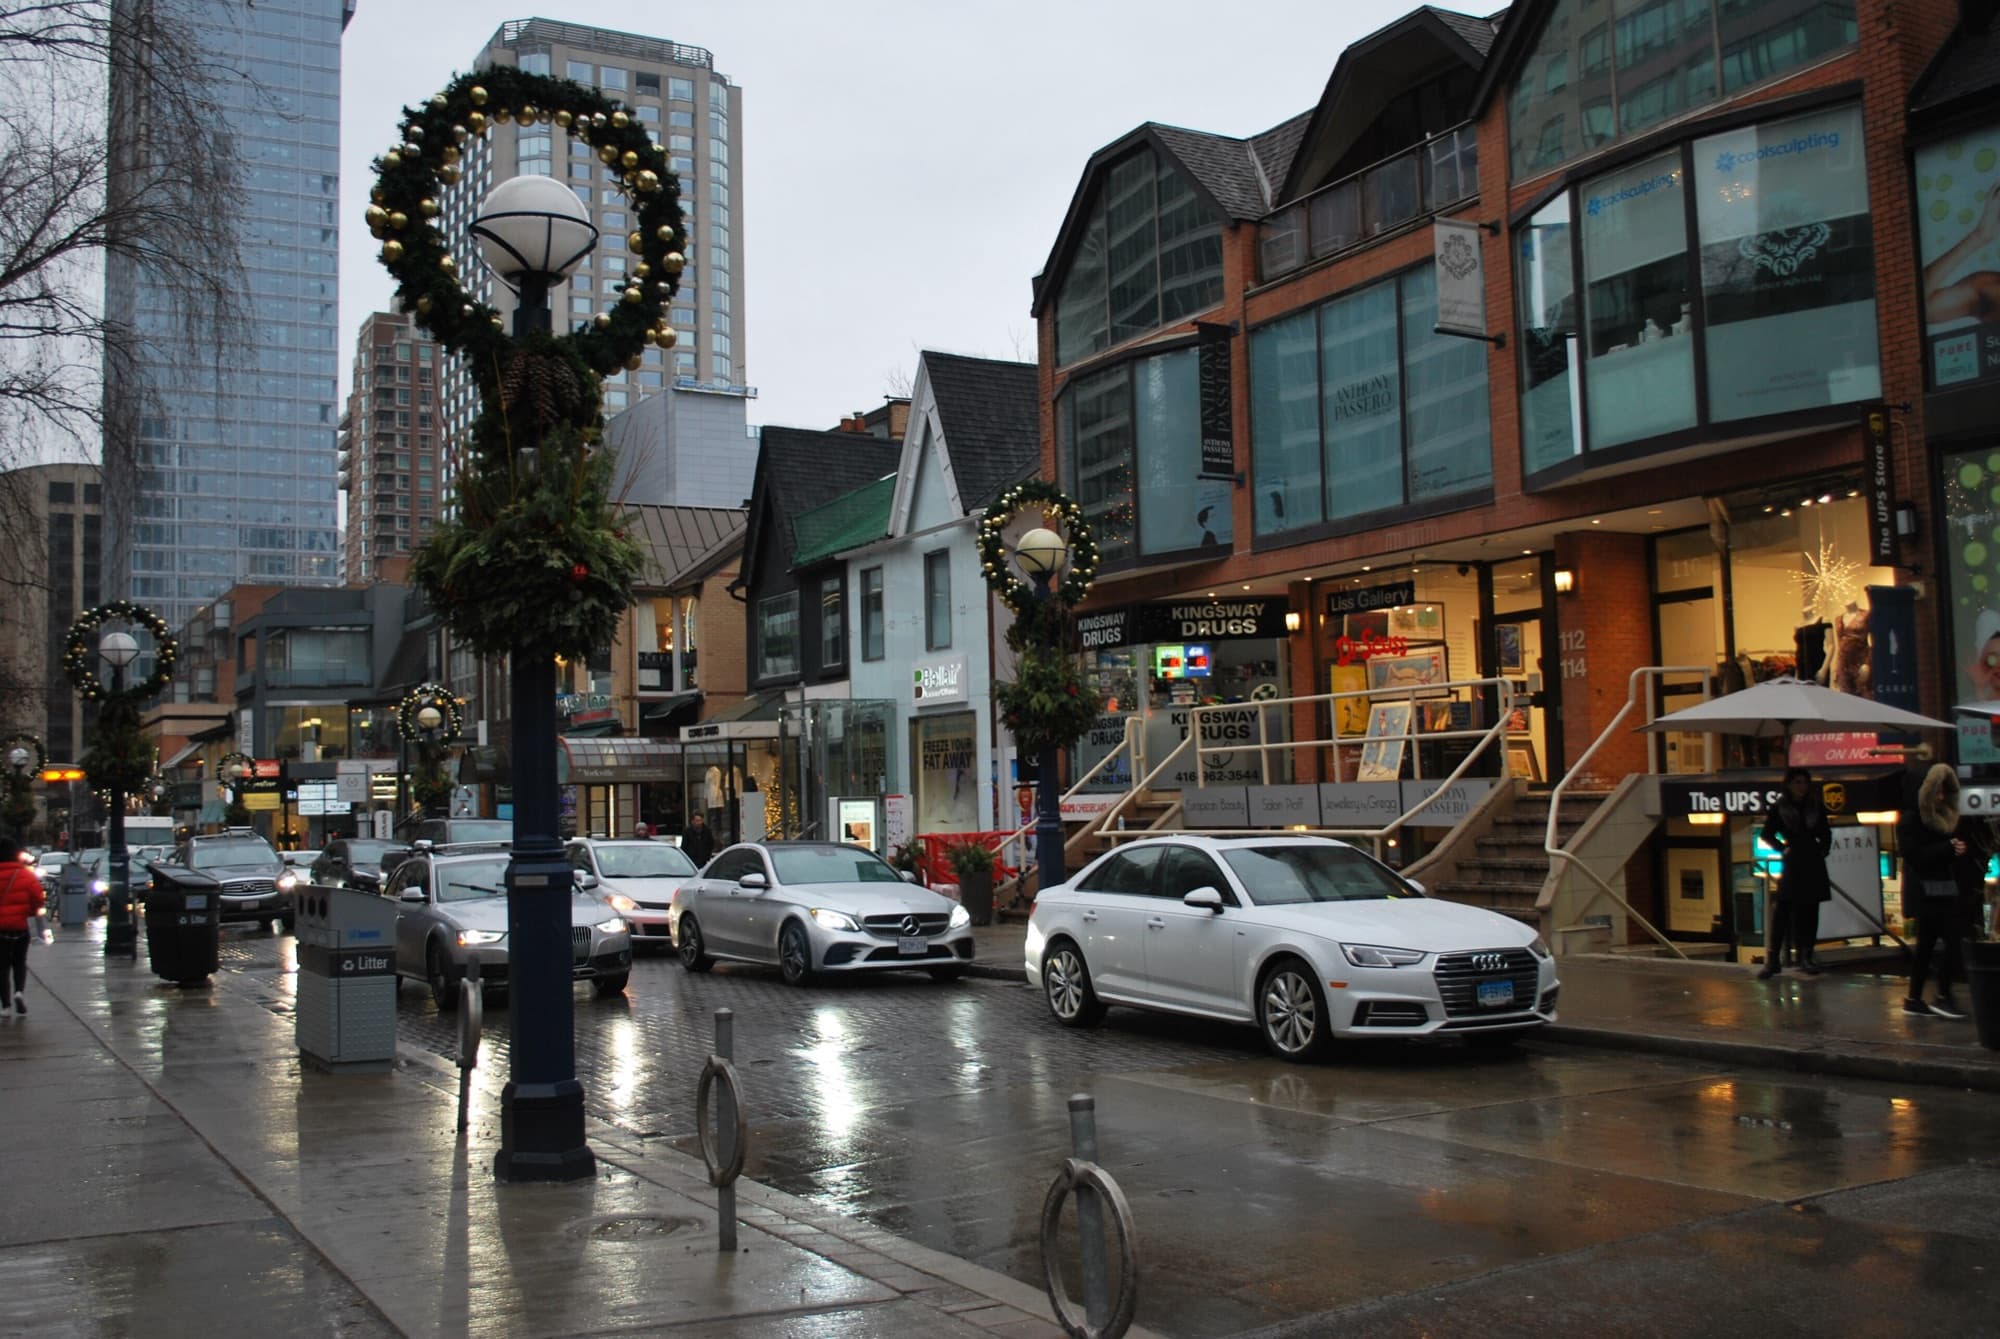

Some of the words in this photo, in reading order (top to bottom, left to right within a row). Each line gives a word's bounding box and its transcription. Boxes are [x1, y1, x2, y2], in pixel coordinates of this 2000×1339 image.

[1737, 132, 1840, 164] coolsculpting
[1601, 173, 1674, 208] coolsculpting
[1336, 391, 1392, 421] PASSERO
[1875, 445, 1887, 486] Store
[1876, 491, 1889, 522] UPS
[1880, 528, 1891, 556] The
[1330, 595, 1355, 612] Liss
[1357, 588, 1409, 609] Gallery
[1172, 603, 1265, 620] KINGSWAY
[1078, 612, 1125, 631] KINGSWAY
[1182, 619, 1257, 637] DRUGS
[1082, 628, 1122, 647] DRUGS
[1360, 627, 1408, 660] Seuss
[1559, 630, 1586, 650] 112
[1560, 658, 1587, 679] 114
[1171, 710, 1258, 726] KIGSWAY
[1961, 725, 1988, 736] PUR
[923, 753, 941, 770] FAT
[943, 751, 972, 769] AWAY
[1825, 749, 1847, 761] ON
[1848, 747, 1880, 759] NO
[1175, 770, 1259, 782] 416962-3544
[1261, 798, 1283, 811] Salon
[1367, 795, 1398, 814] Gregg
[1422, 799, 1470, 815] ASSERO
[1689, 791, 1721, 811] The
[1725, 791, 1761, 812] UPS
[191, 914, 207, 924] Litter
[358, 957, 388, 971] Litter
